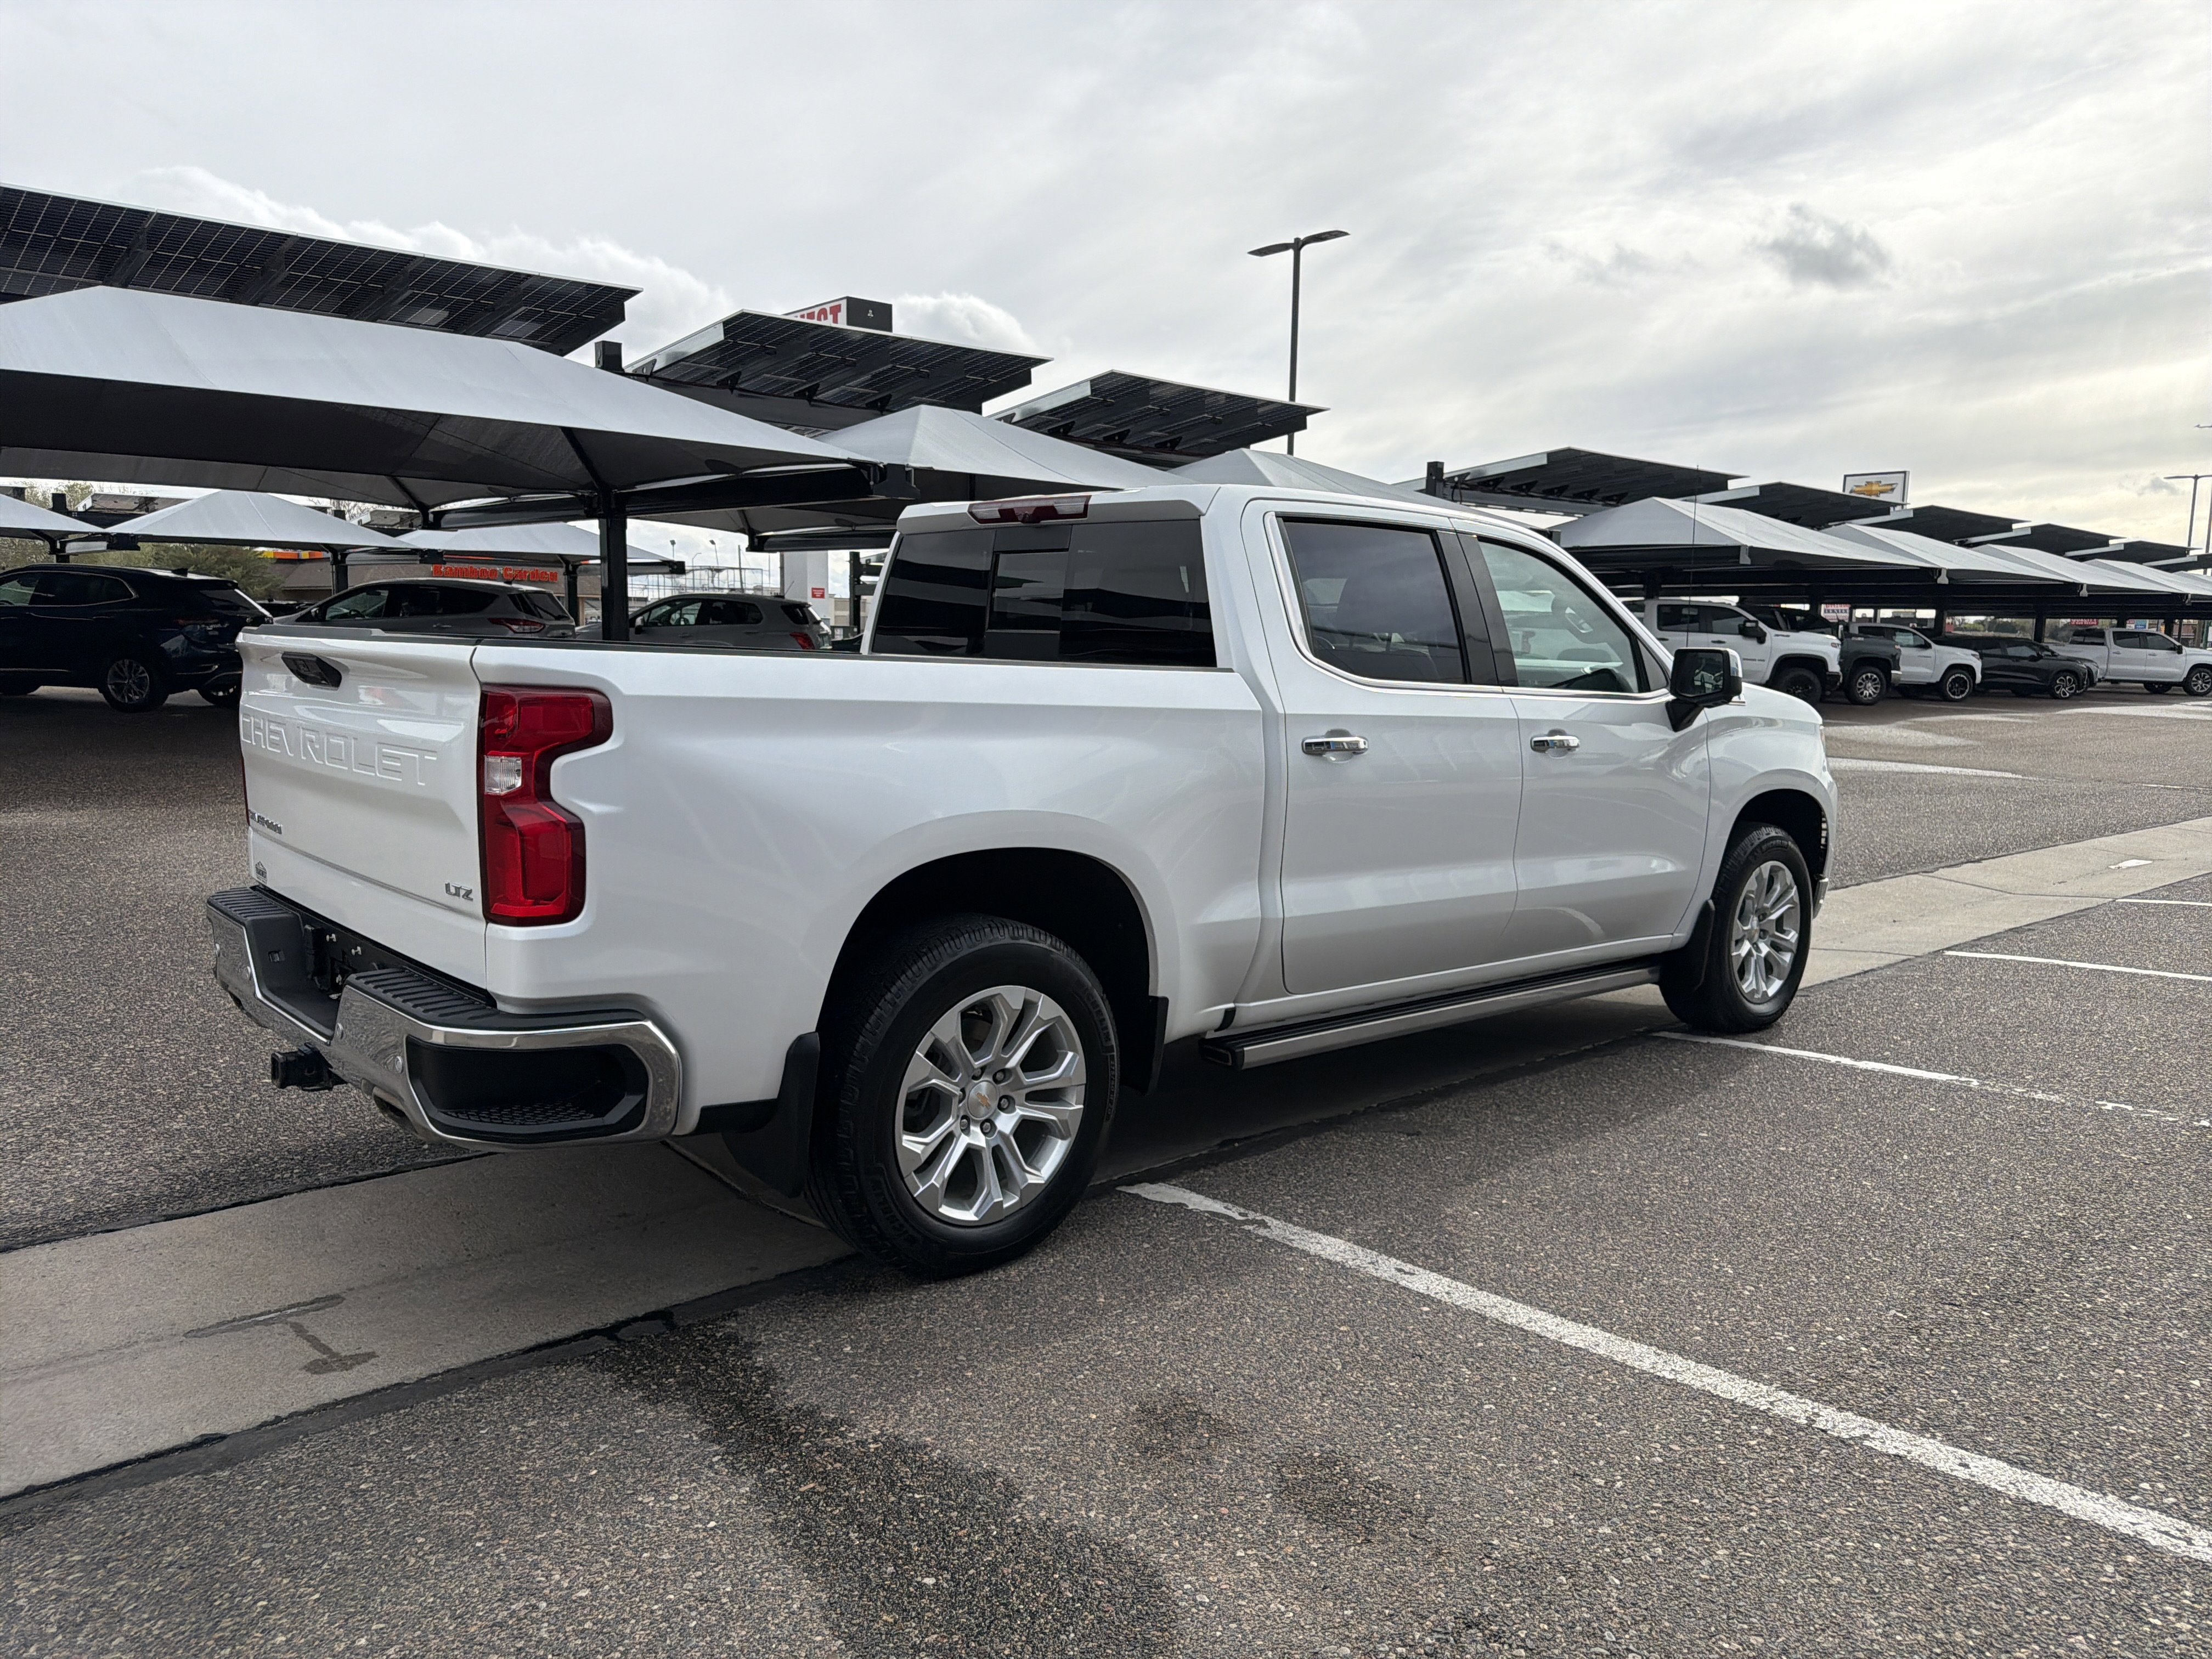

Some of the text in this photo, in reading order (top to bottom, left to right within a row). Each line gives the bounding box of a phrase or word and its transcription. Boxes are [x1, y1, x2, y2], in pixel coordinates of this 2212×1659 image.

[432, 564, 558, 582] Bamboo Garden
[240, 713, 437, 786] CHEVROLET
[444, 882, 473, 901] LTZ
